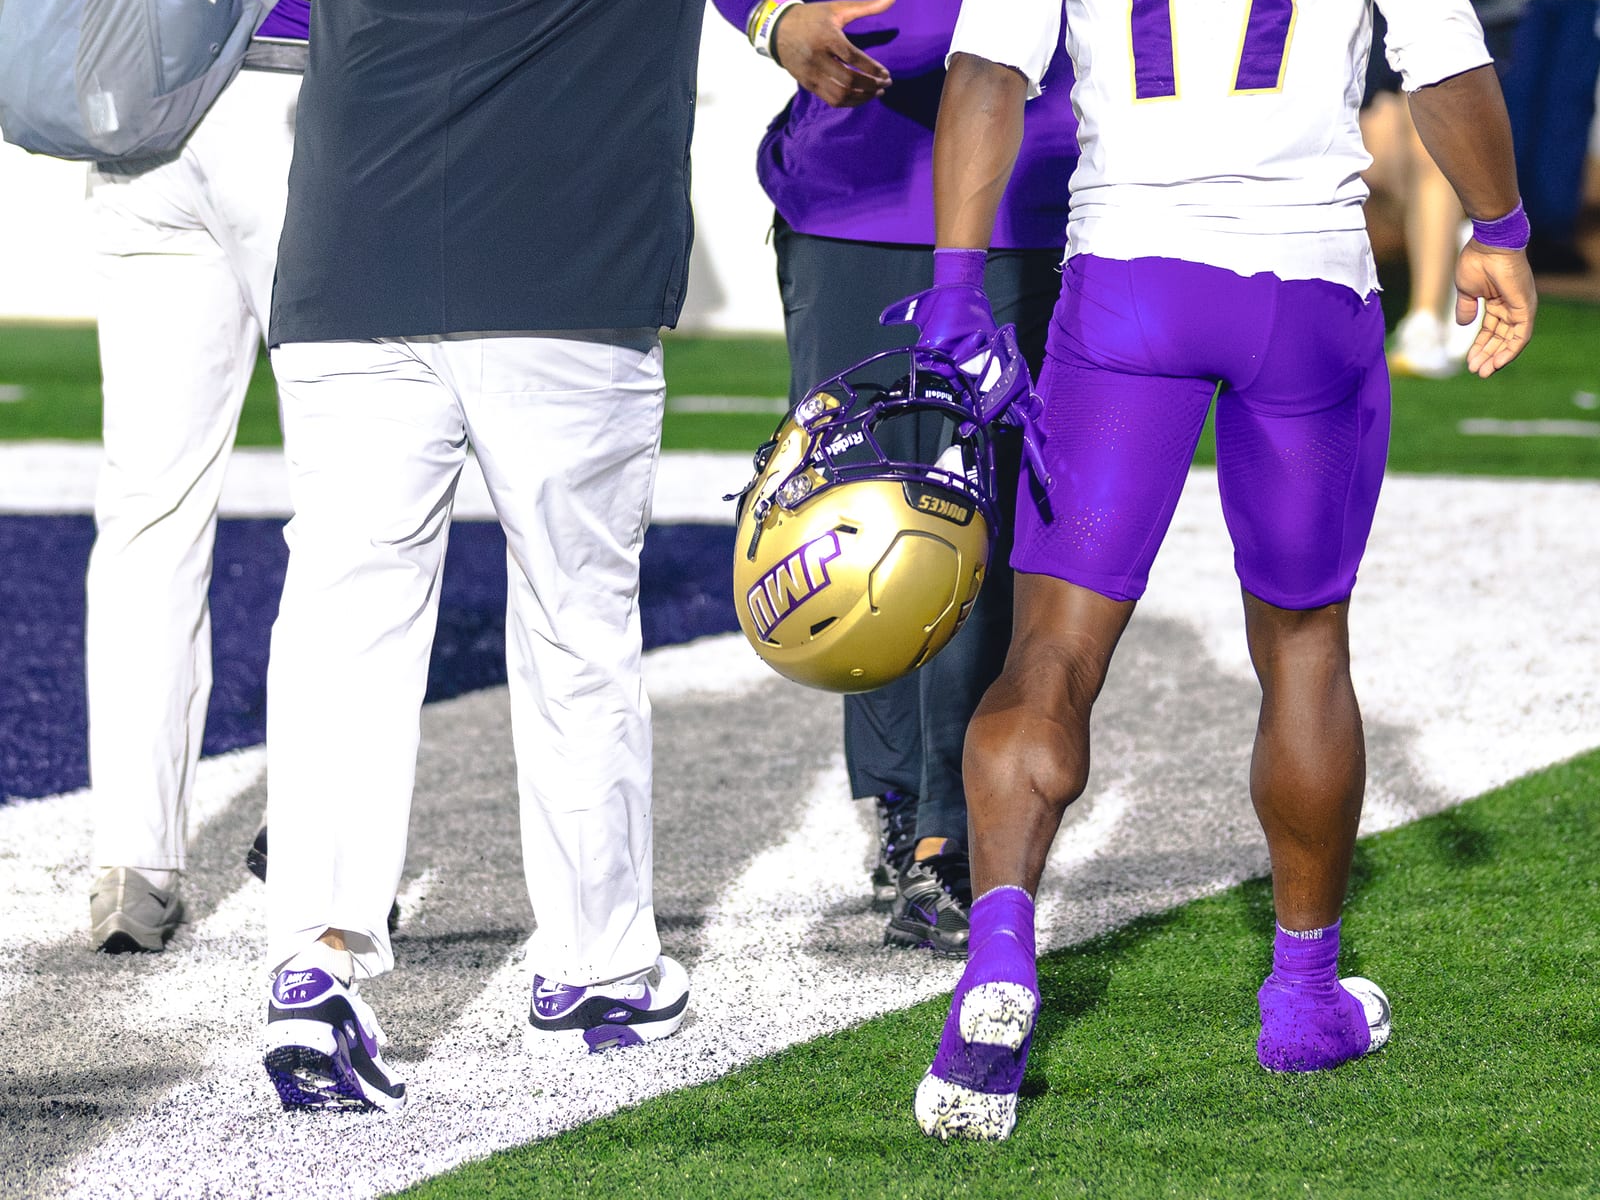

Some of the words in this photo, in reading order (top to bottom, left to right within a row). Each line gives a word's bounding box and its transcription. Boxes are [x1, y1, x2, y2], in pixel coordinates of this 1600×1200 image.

[917, 494, 969, 522] DUKES
[747, 529, 841, 641] JMU
[283, 990, 307, 1000] AIR
[537, 1000, 559, 1012] AIR
